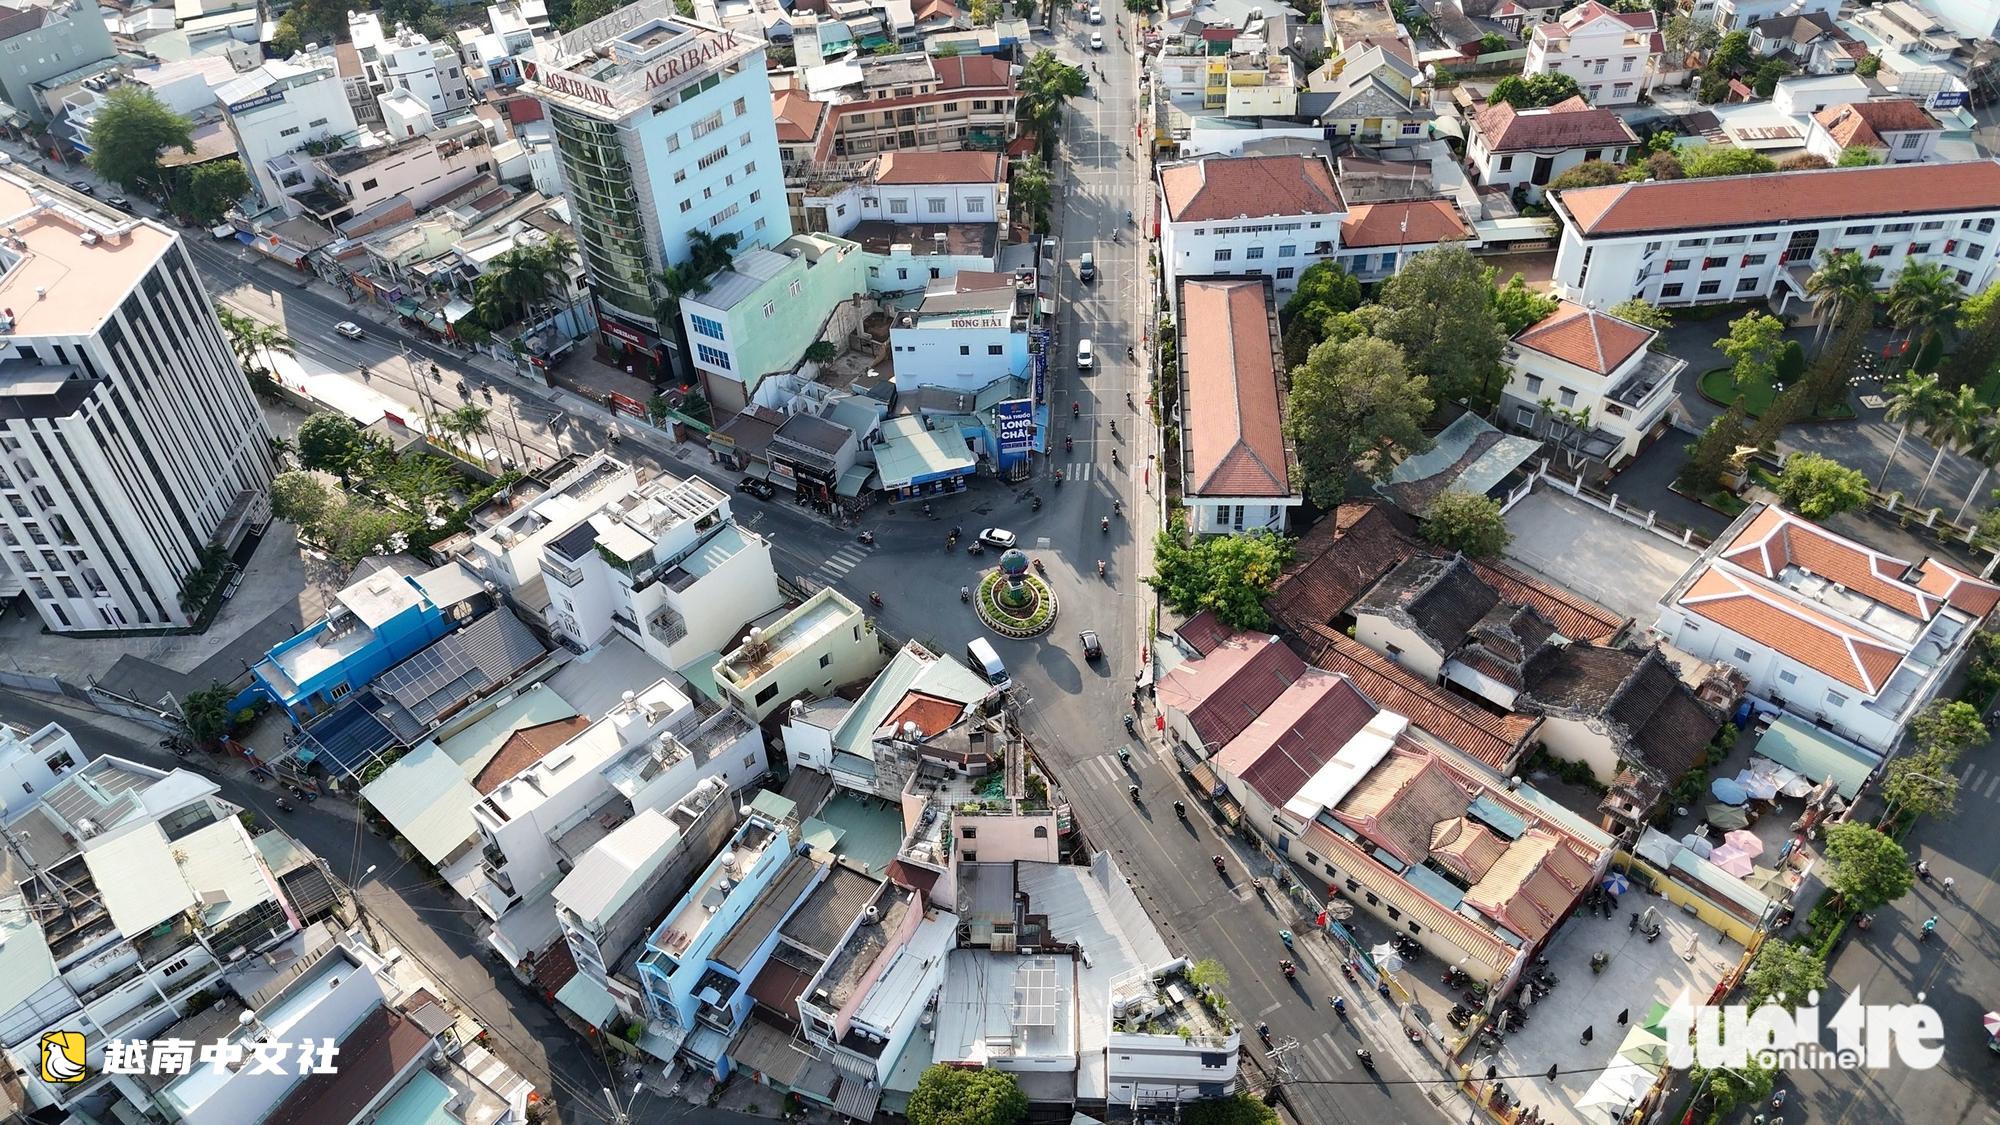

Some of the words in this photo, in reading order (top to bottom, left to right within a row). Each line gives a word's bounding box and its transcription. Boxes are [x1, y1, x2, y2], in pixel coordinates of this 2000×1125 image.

[645, 29, 738, 91] AGRIBANK
[546, 72, 614, 108] AGRIBANK
[1002, 419, 1031, 430] LONG
